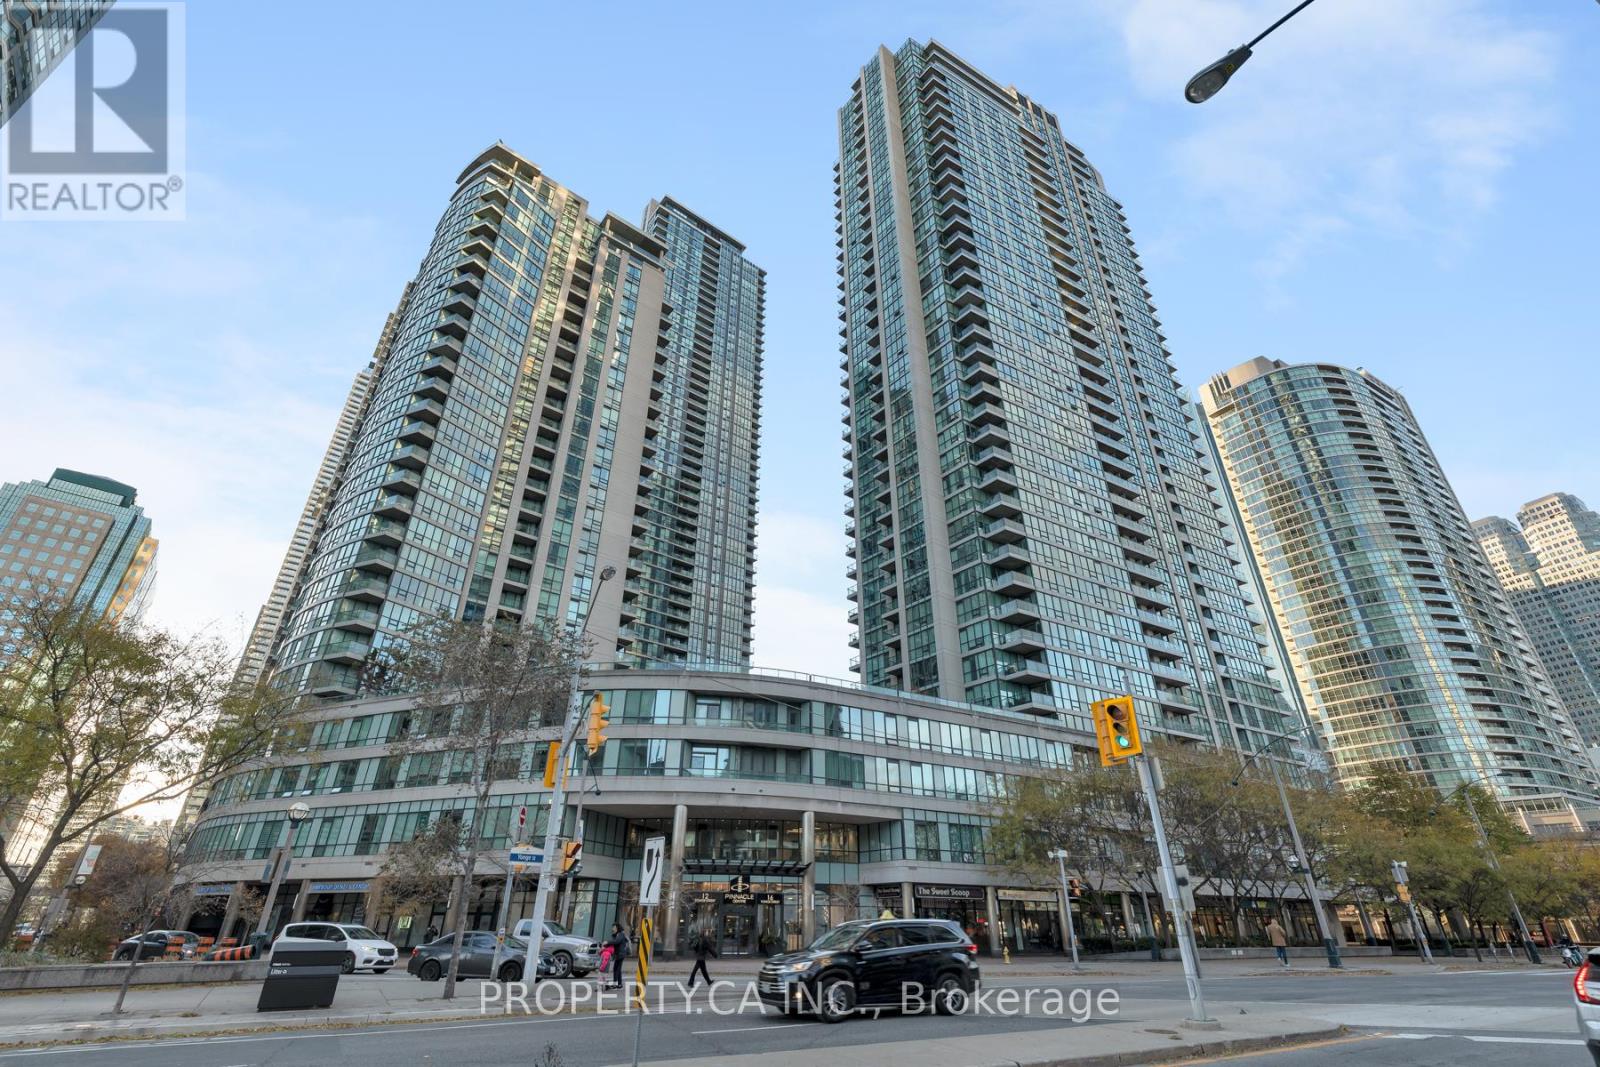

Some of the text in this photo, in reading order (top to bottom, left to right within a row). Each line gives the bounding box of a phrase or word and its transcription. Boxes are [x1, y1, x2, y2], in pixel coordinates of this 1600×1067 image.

[919, 887, 970, 897] The Sweet Scoop
[724, 893, 755, 901] PINNACLE
